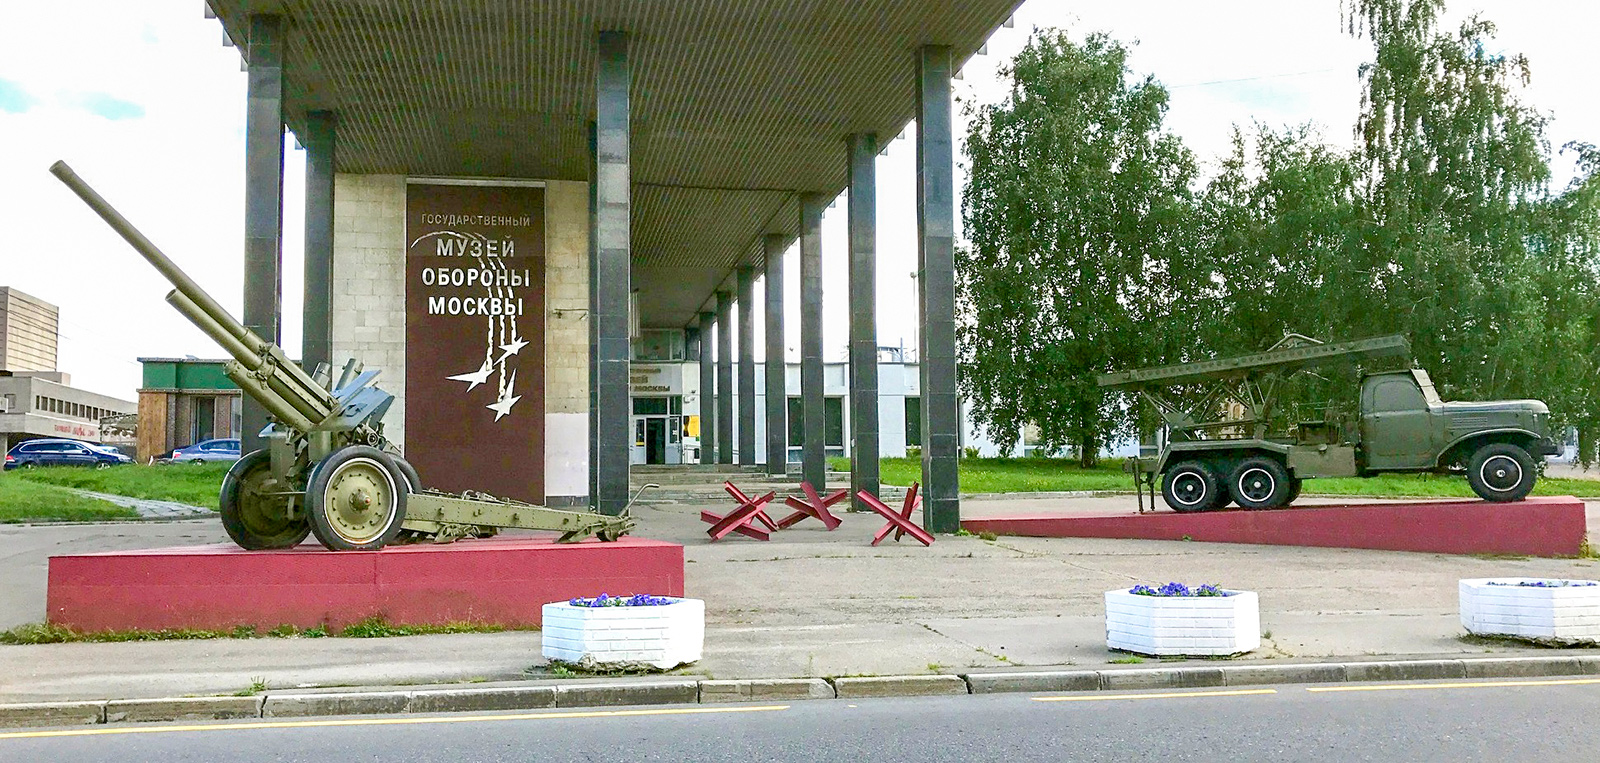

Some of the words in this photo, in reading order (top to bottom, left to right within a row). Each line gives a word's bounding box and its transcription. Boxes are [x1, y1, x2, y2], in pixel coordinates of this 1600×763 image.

[421, 214, 530, 226] ГОСУДАРСТВЕННЫЙ
[437, 235, 515, 257] МУЗЕЙ
[422, 268, 530, 287] ОБОРОНЫ
[428, 297, 523, 316] МОСКВЫ
